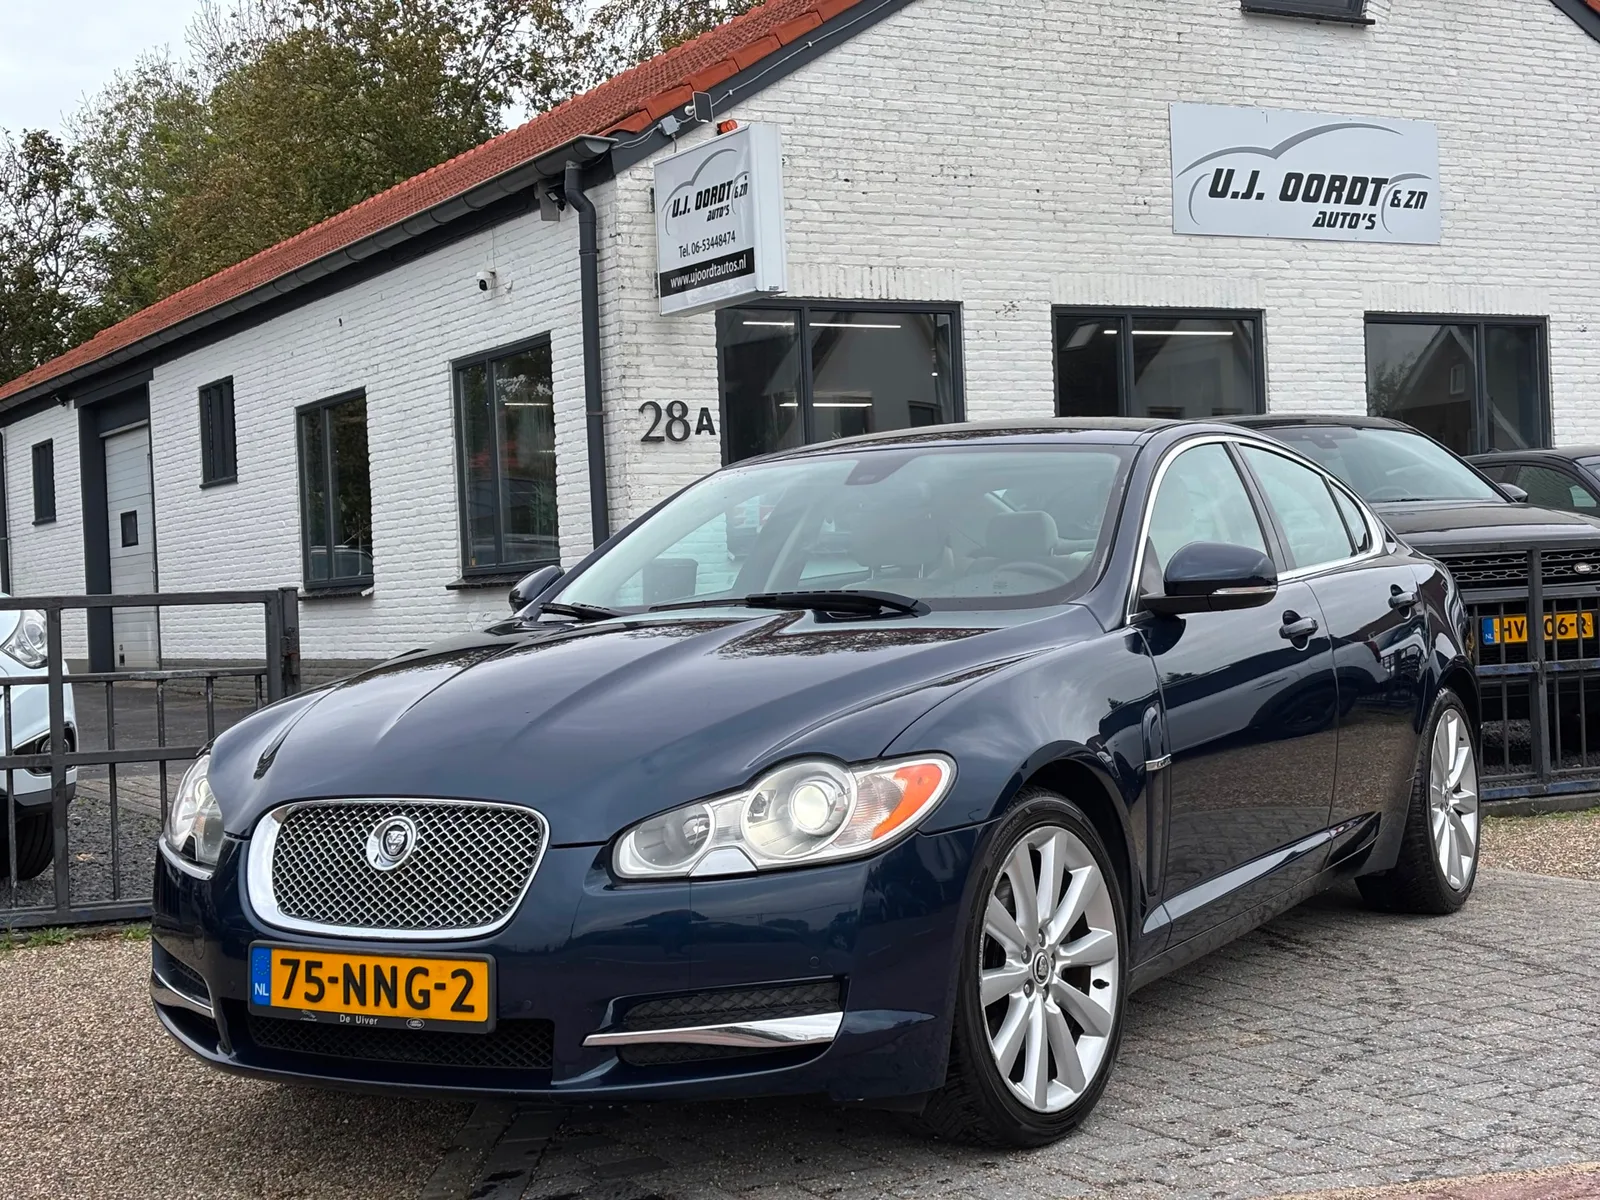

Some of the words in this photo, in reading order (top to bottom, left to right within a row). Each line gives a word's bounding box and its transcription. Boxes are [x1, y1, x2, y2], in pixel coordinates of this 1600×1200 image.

[672, 195, 691, 218] U.J.
[694, 180, 734, 211] OORDT
[1208, 168, 1265, 200] U.J.
[1279, 172, 1389, 206] OORDT
[1389, 189, 1402, 208] &
[706, 204, 730, 222] AUTO'S
[1312, 211, 1377, 230] AUTO'S
[678, 243, 690, 258] Tel.
[691, 230, 736, 255] 06-53448474
[670, 254, 747, 288] www.ujoordtautos.nl
[254, 982, 270, 997] NL
[280, 958, 475, 1013] 75-NNG-2
[340, 1014, 350, 1024] De
[355, 1015, 379, 1025] Uiver
